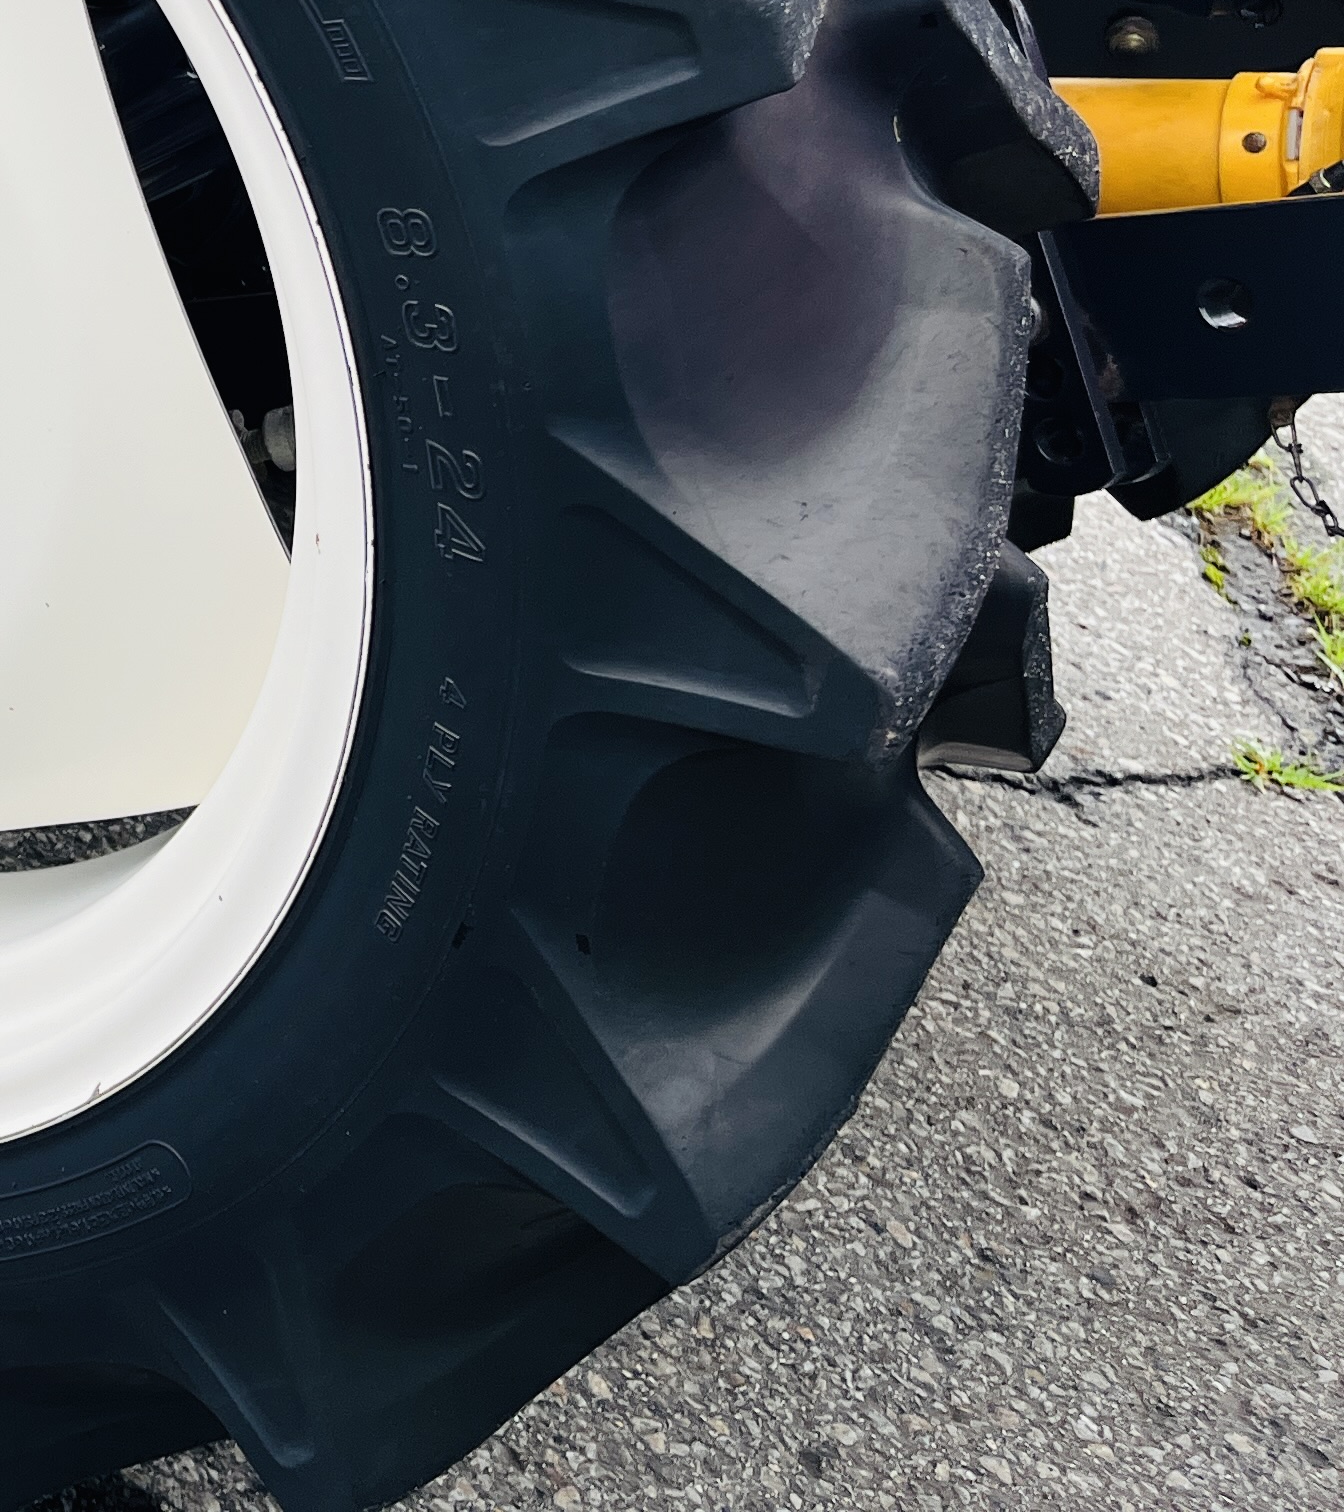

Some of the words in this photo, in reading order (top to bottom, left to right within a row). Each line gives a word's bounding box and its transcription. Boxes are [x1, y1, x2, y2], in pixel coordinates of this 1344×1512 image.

[376, 206, 487, 565] 8.3-24
[439, 676, 468, 710] 4
[422, 720, 462, 805] PLY
[374, 804, 441, 945] RATING
